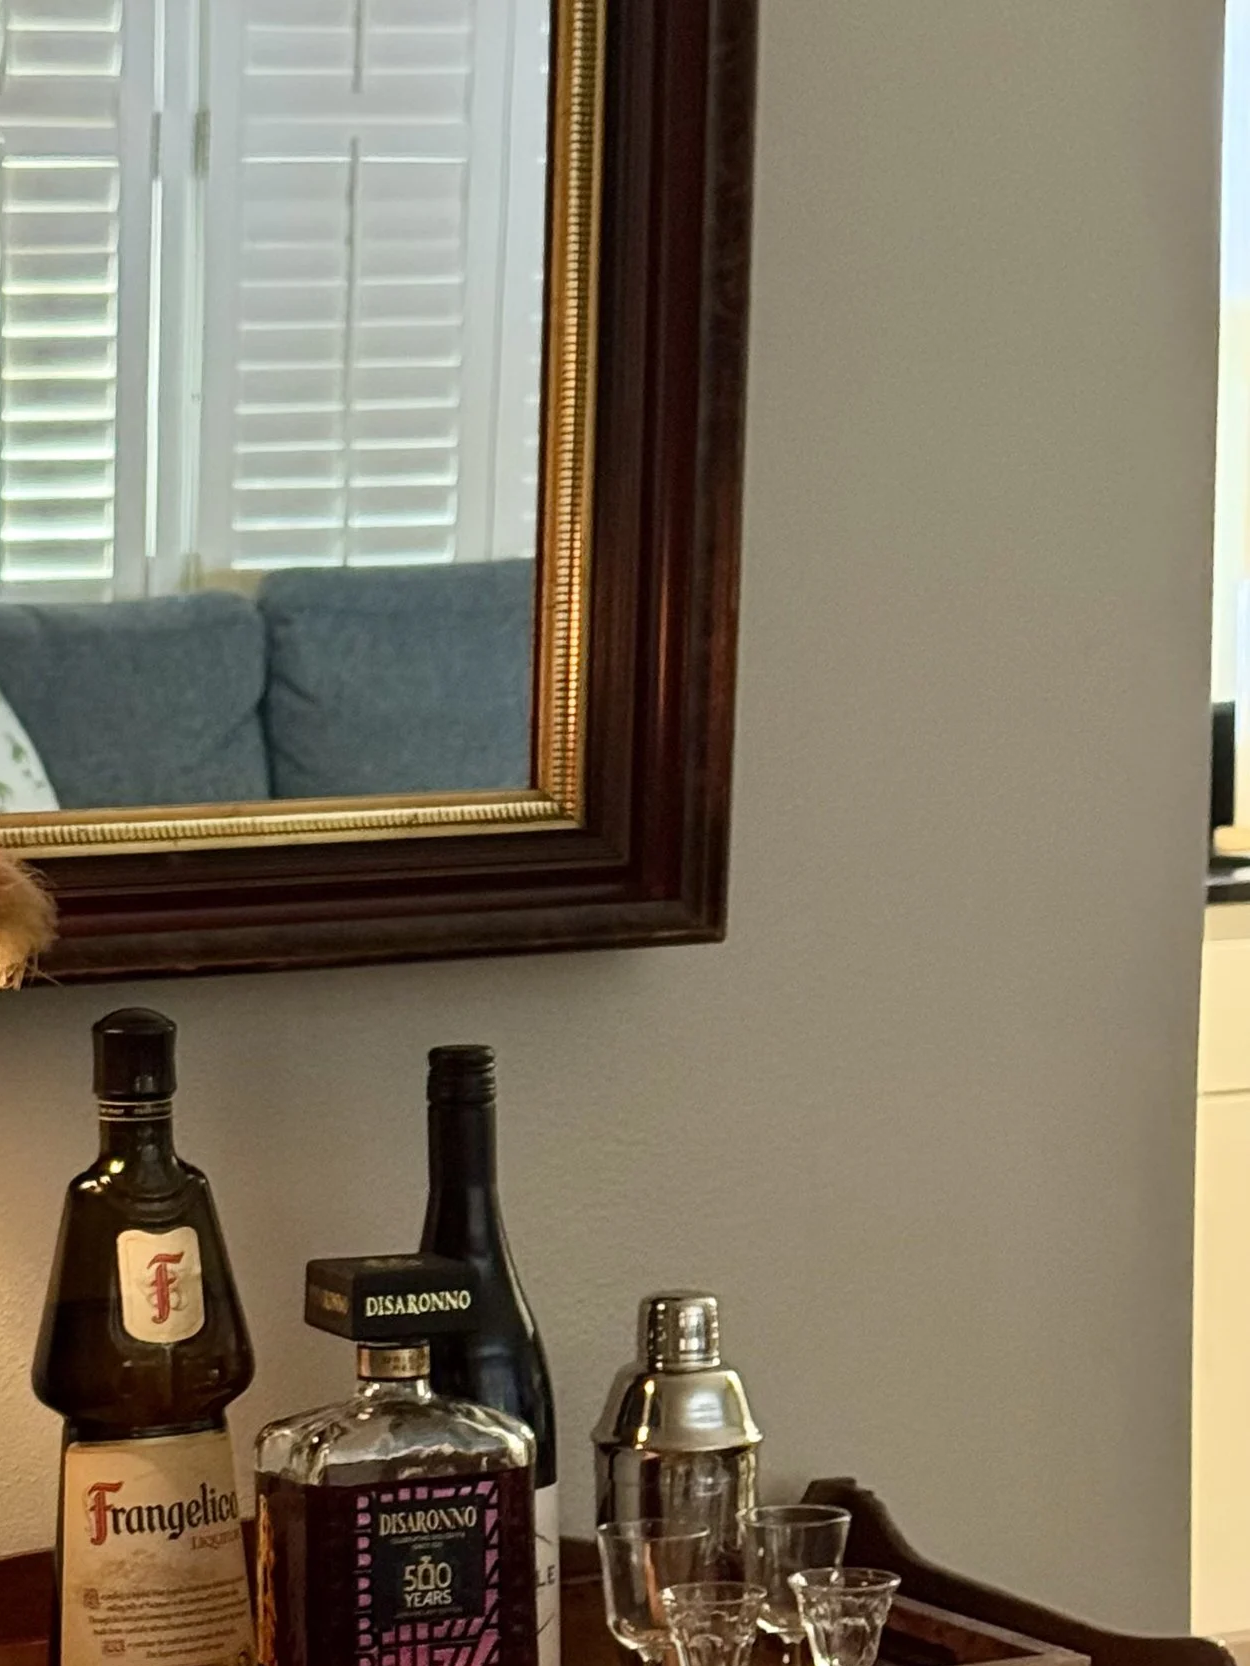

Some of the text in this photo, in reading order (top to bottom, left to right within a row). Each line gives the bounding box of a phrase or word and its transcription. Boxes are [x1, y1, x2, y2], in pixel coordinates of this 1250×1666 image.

[365, 1290, 472, 1318] DISARONNO
[87, 1480, 239, 1546] Frangelico
[379, 1505, 477, 1537] DISARONNO
[404, 1589, 453, 1608] YEARS
